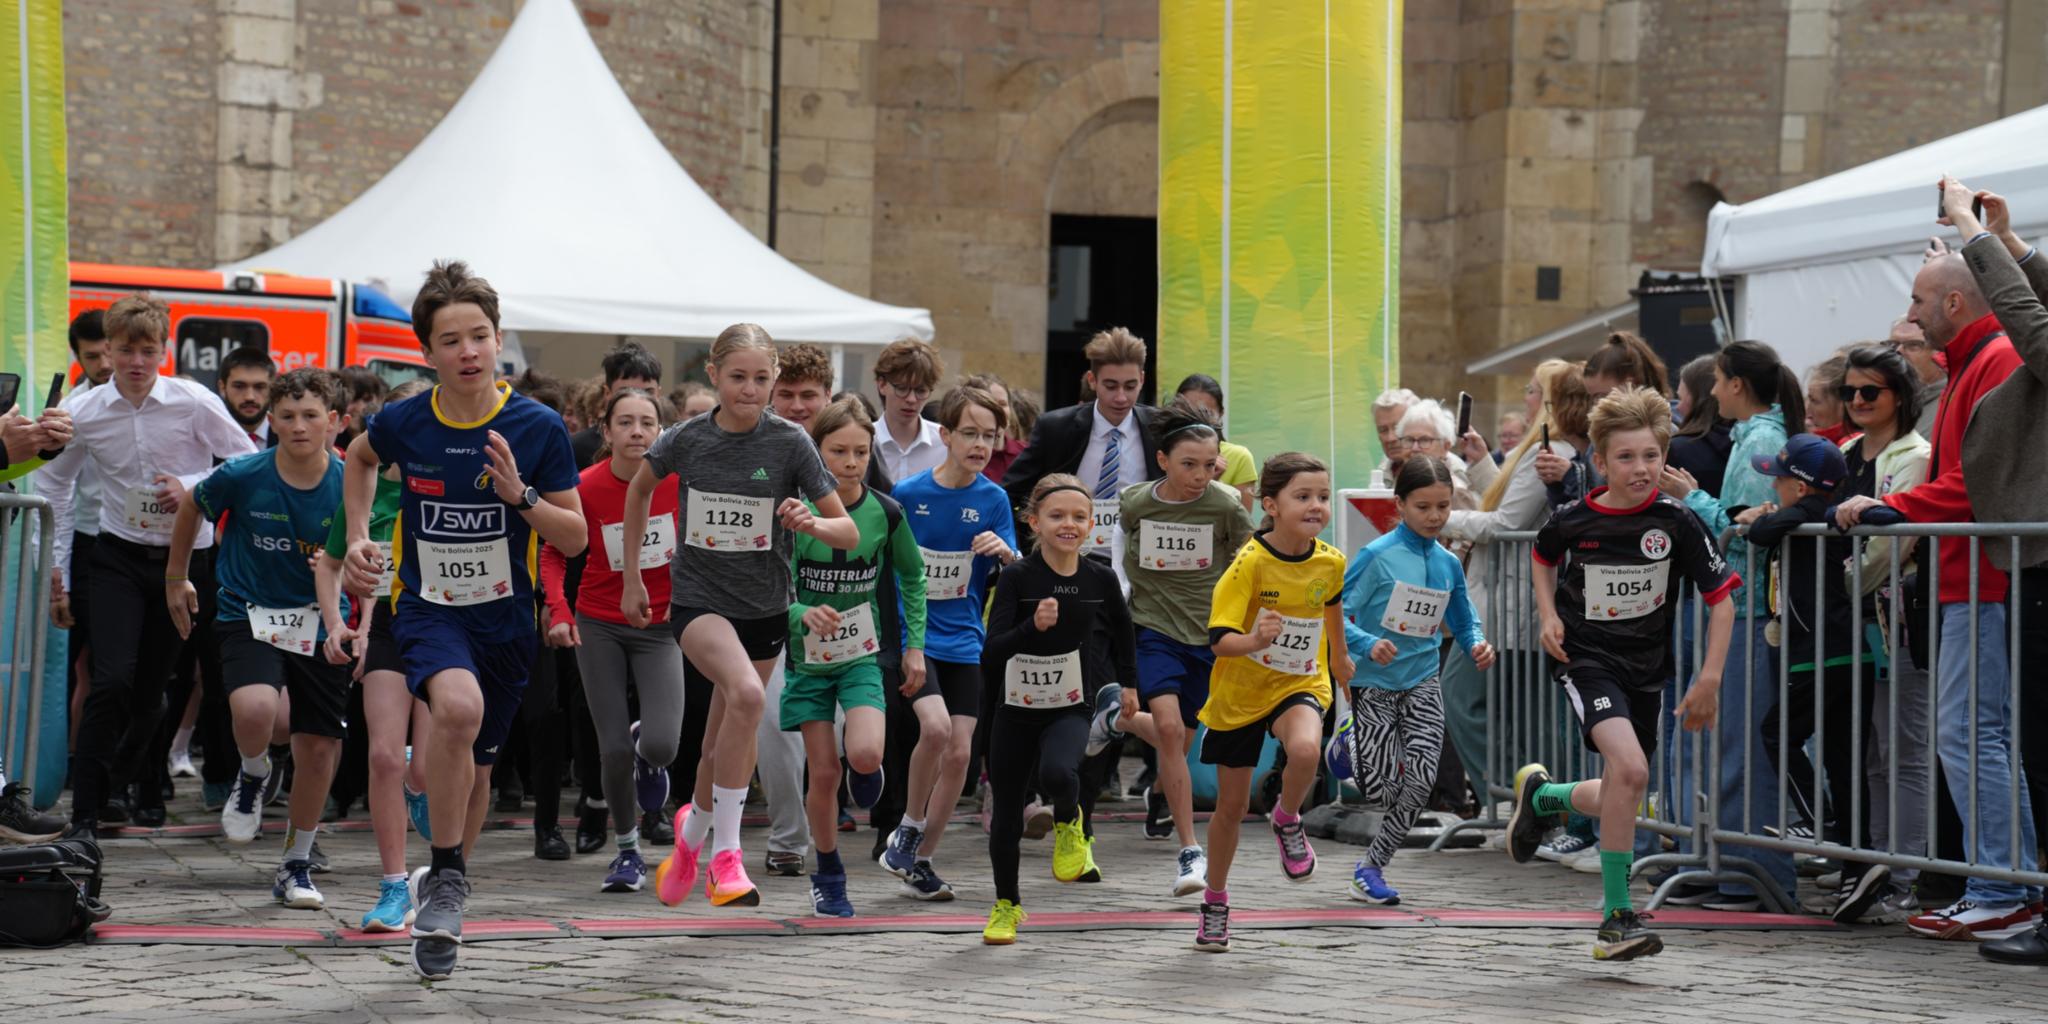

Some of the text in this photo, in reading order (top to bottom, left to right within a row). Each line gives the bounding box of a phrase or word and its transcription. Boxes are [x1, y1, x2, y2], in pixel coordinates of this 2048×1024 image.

[718, 496, 742, 505] Bolivia
[743, 499, 761, 507] 2025
[443, 510, 497, 530] SWT
[705, 510, 753, 528] 1128
[1166, 525, 1187, 533] Bolivia
[252, 533, 292, 551] BSG
[431, 545, 494, 554] Viva Bolivia 2025
[1156, 537, 1196, 551] 1116
[1578, 541, 1600, 549] JAKO
[438, 560, 489, 578] 1051
[800, 565, 878, 582] SILVESTERLAUF
[924, 565, 960, 578] 1114
[1617, 567, 1642, 575] Bolivia
[806, 579, 836, 593] TRIER
[838, 584, 852, 593] 30
[1052, 585, 1079, 594] JAKO
[1605, 579, 1654, 597] 1054
[1404, 599, 1438, 617] 1131
[268, 613, 304, 628] 1124
[1020, 670, 1063, 685] 1117
[1593, 696, 1612, 711] SB
